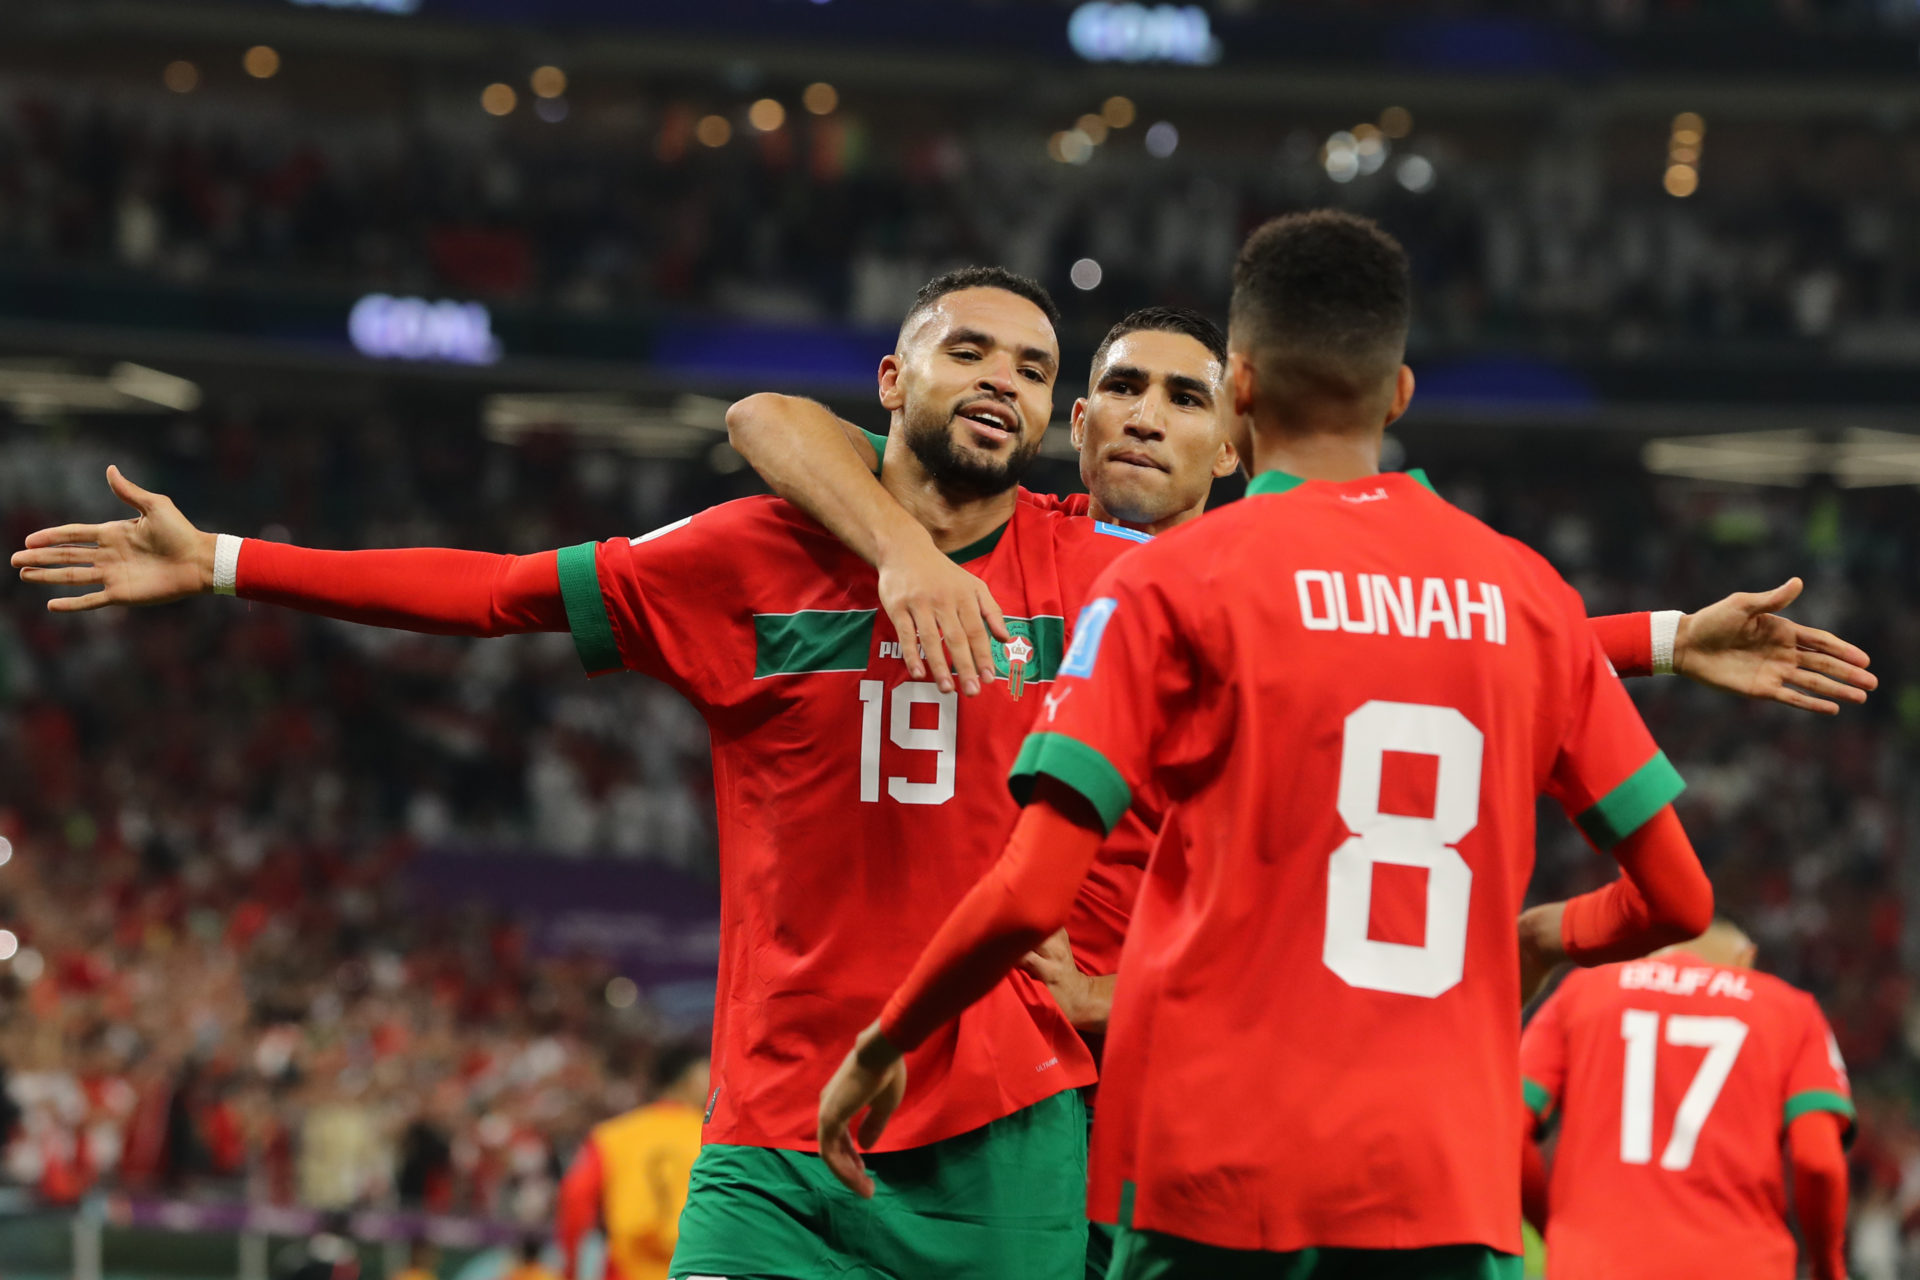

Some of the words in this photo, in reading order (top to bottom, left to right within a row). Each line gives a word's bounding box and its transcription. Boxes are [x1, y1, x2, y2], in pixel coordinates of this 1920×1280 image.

[1294, 569, 1507, 646] OUNAHI
[859, 679, 958, 805] 19
[1322, 699, 1485, 999] 8
[1619, 962, 1753, 1001] BOUFAL
[1620, 1008, 1749, 1171] 17
